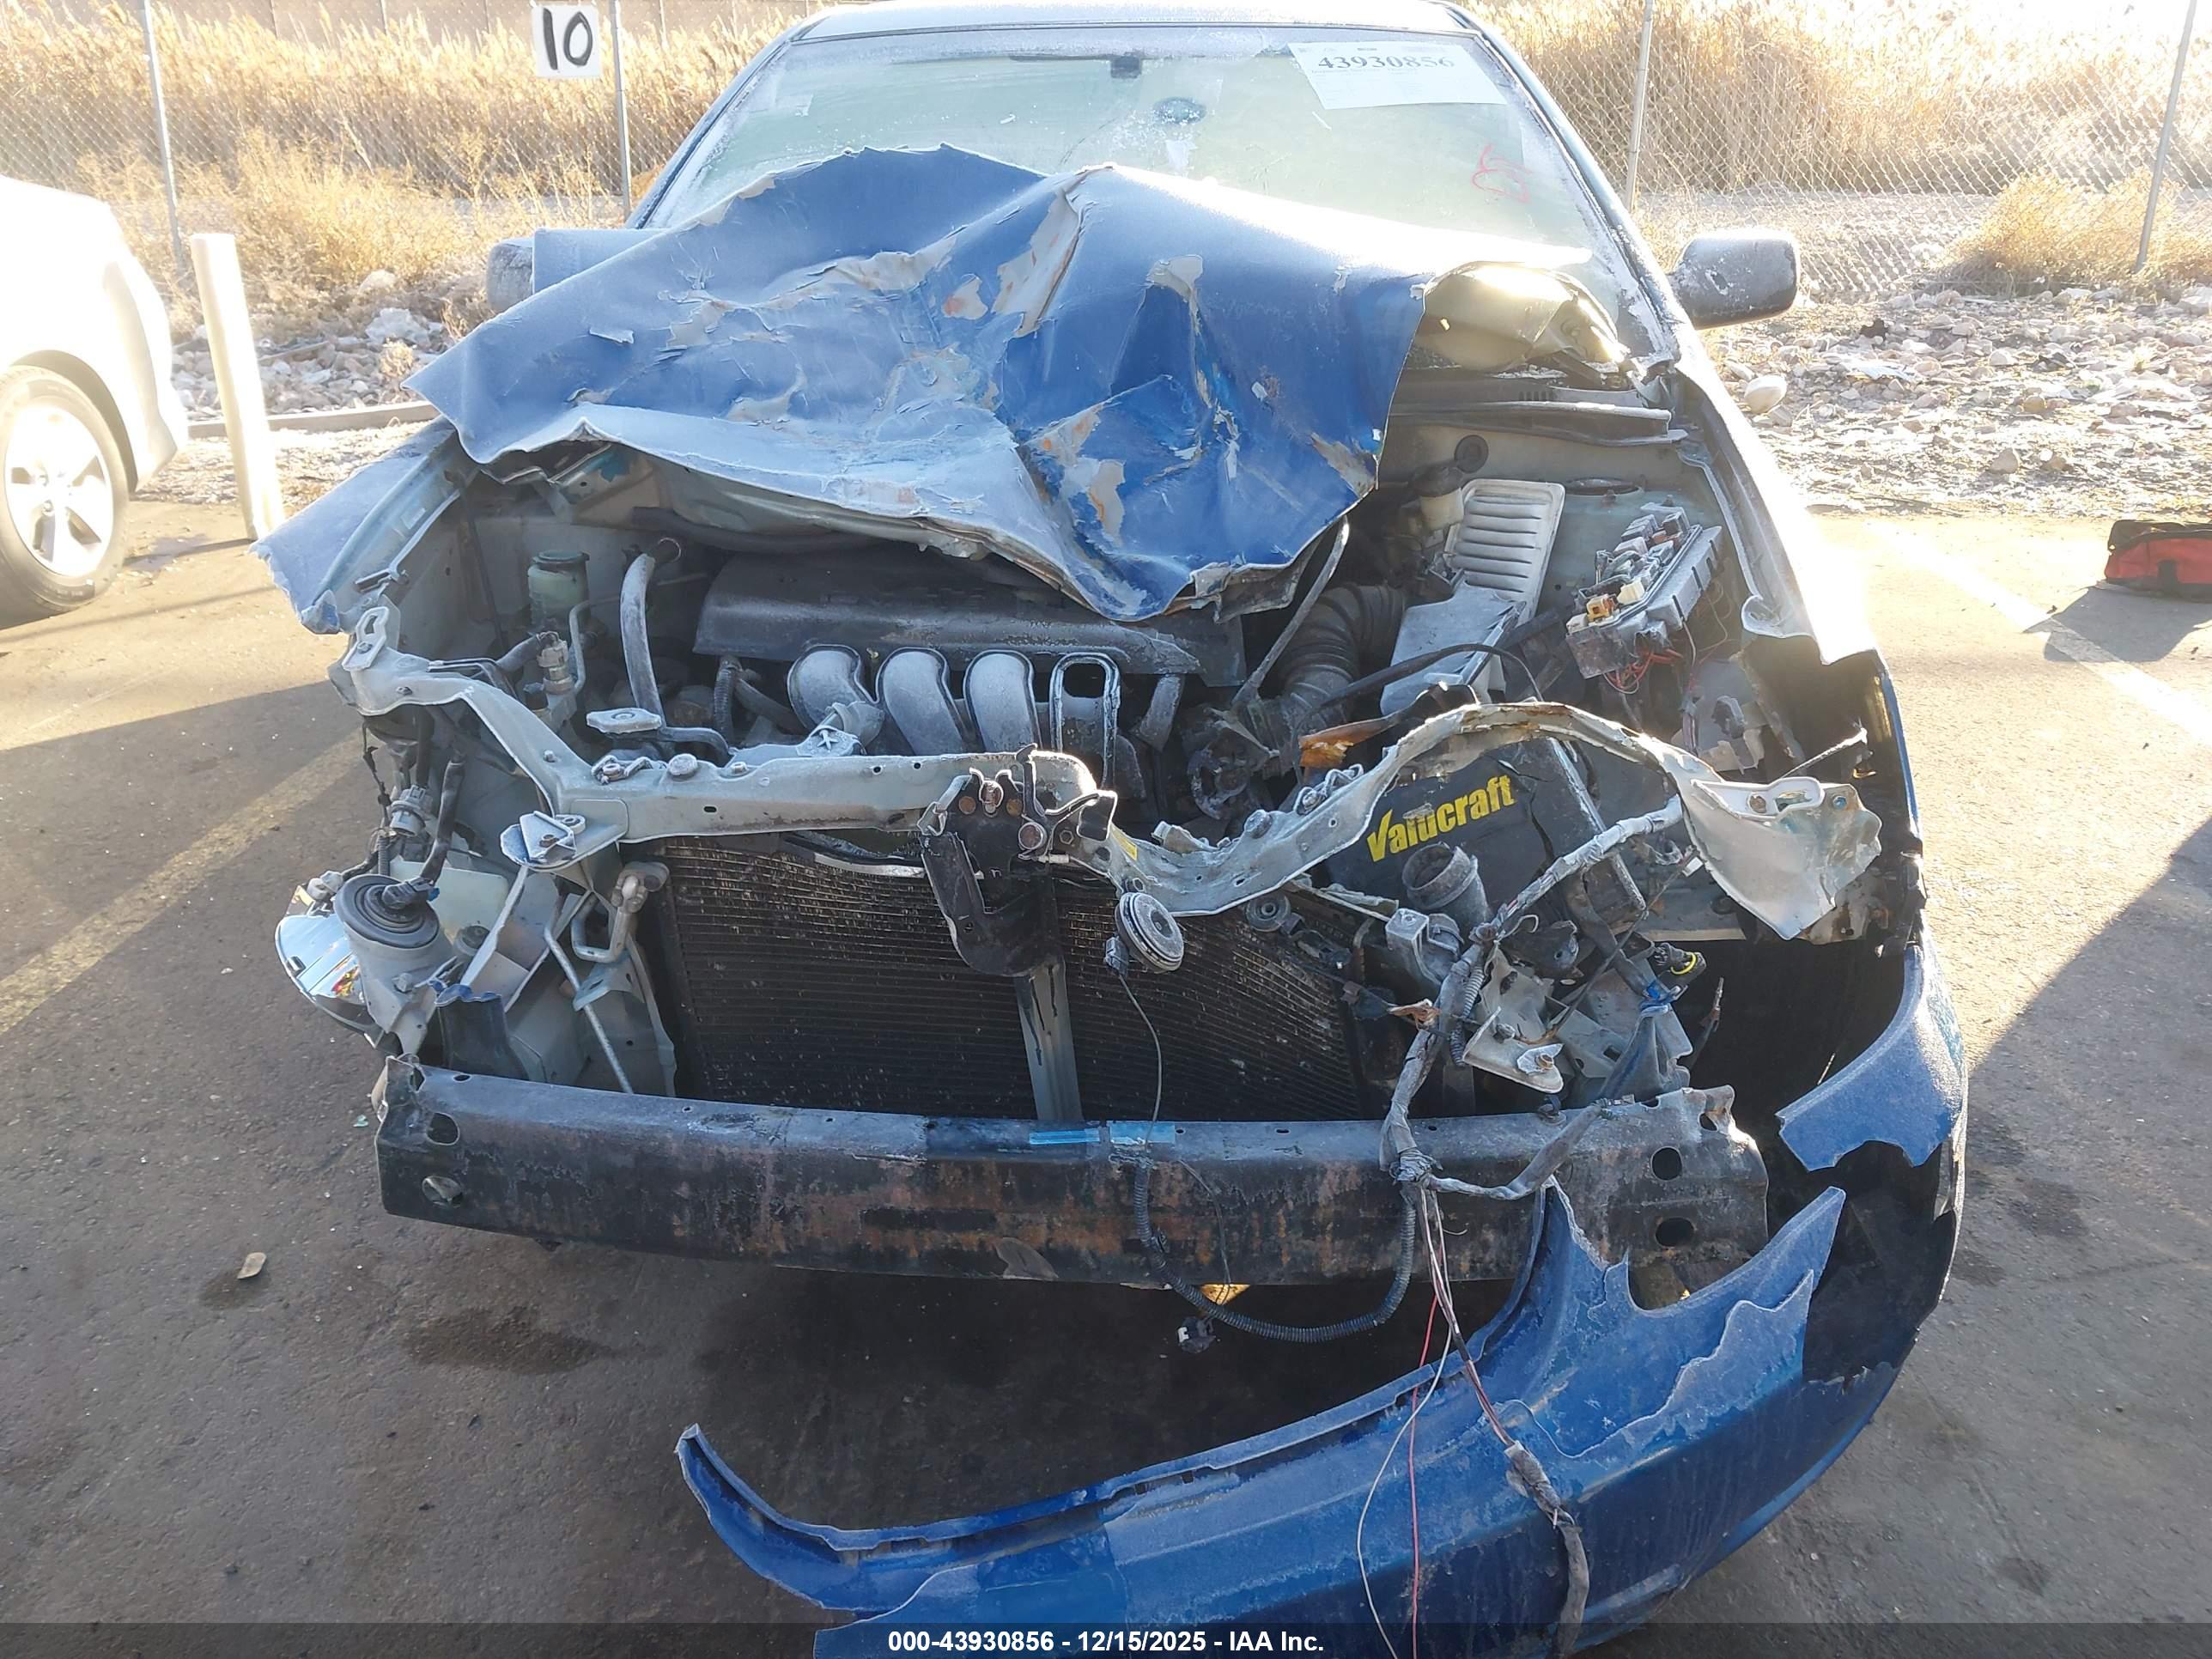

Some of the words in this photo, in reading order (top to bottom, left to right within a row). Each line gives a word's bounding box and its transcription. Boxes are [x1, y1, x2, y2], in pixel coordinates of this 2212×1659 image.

[543, 7, 593, 70] 10
[1318, 55, 1455, 69] 43930856
[1366, 774, 1517, 863] Valucraft
